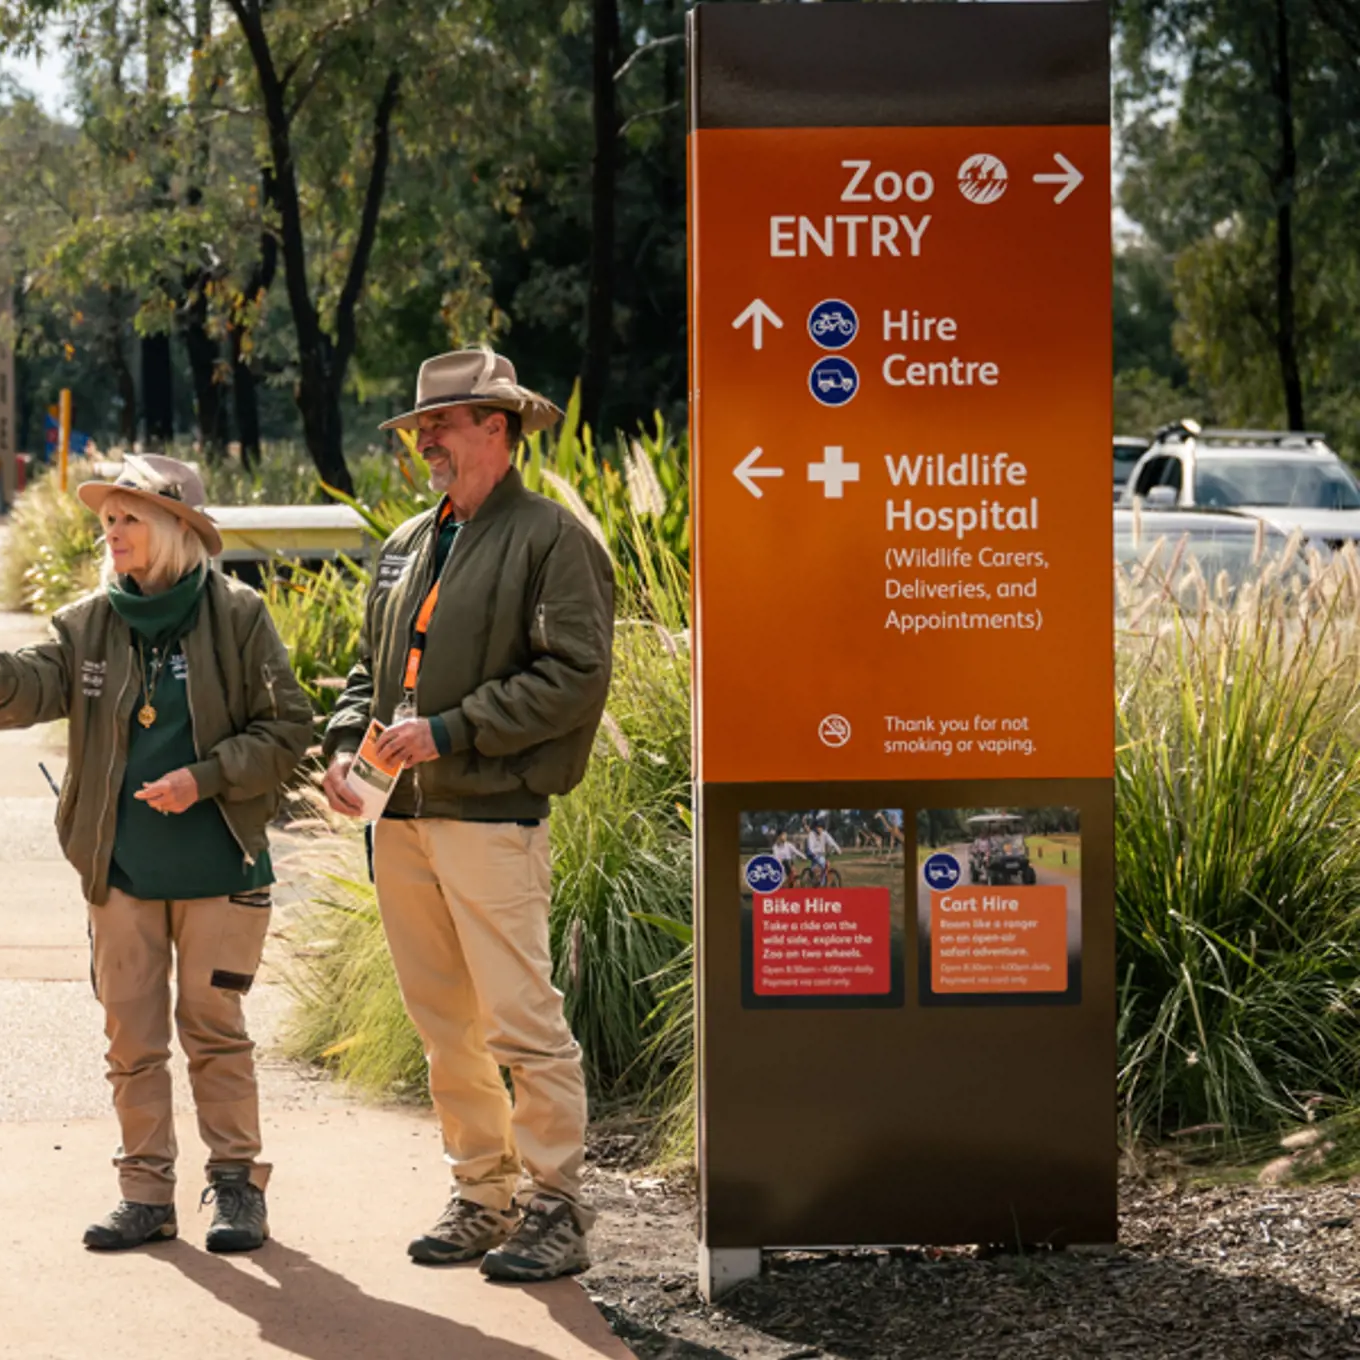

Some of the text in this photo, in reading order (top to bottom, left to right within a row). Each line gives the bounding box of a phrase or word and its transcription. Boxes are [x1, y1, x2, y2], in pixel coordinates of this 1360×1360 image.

[841, 160, 933, 201] Zoo
[771, 215, 931, 257] ENTRY
[884, 310, 957, 341] Hire
[883, 354, 998, 386] Centre
[885, 453, 1027, 486] Wildlife
[886, 498, 1037, 539] Hospital
[885, 547, 1048, 569] (Wildlife Carers,
[886, 578, 1036, 600] Deliveries, and
[885, 609, 1043, 634] Appointments)
[884, 715, 1028, 735] Thank you for not
[884, 737, 1036, 756] smoking or vaping.
[763, 898, 841, 914] Bike Hire
[940, 896, 1018, 912] Cart Hire
[764, 920, 789, 931] Take
[800, 921, 821, 930] ride
[823, 922, 837, 930] on
[839, 921, 857, 930] the
[973, 919, 991, 928] like
[813, 935, 852, 946] explore
[854, 934, 872, 944] the
[763, 948, 783, 959] Zoo
[786, 950, 800, 958] on
[802, 949, 822, 958] two
